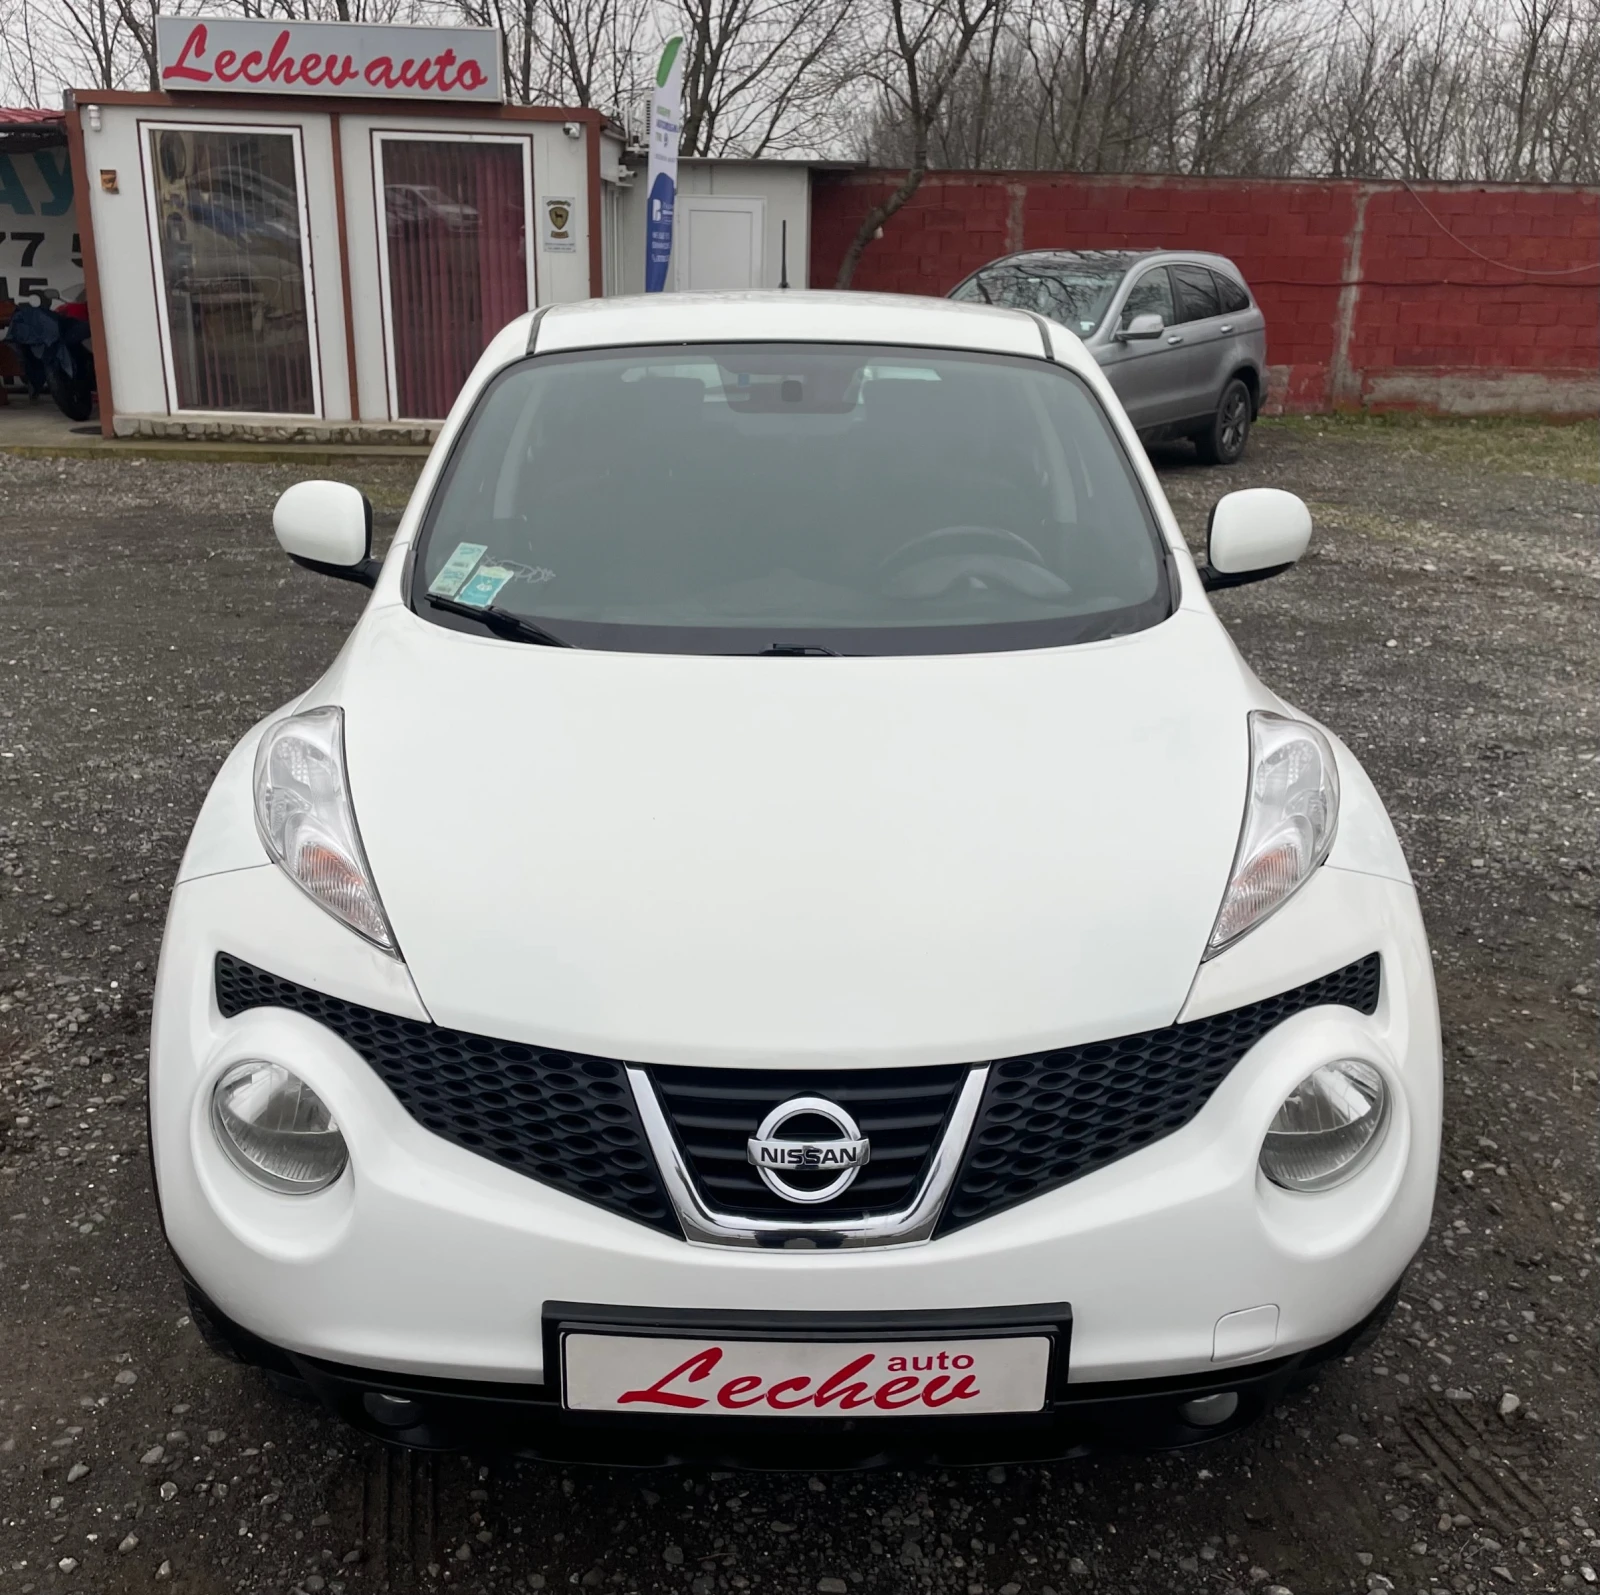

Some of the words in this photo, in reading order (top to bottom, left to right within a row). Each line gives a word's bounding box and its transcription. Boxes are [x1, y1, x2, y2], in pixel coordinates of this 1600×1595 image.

[163, 24, 359, 86] Lechev
[364, 49, 488, 91] auto
[0, 232, 45, 267] 7
[761, 1146, 857, 1164] NISSAN
[617, 1346, 980, 1411] Lechev
[887, 1351, 975, 1373] auto
